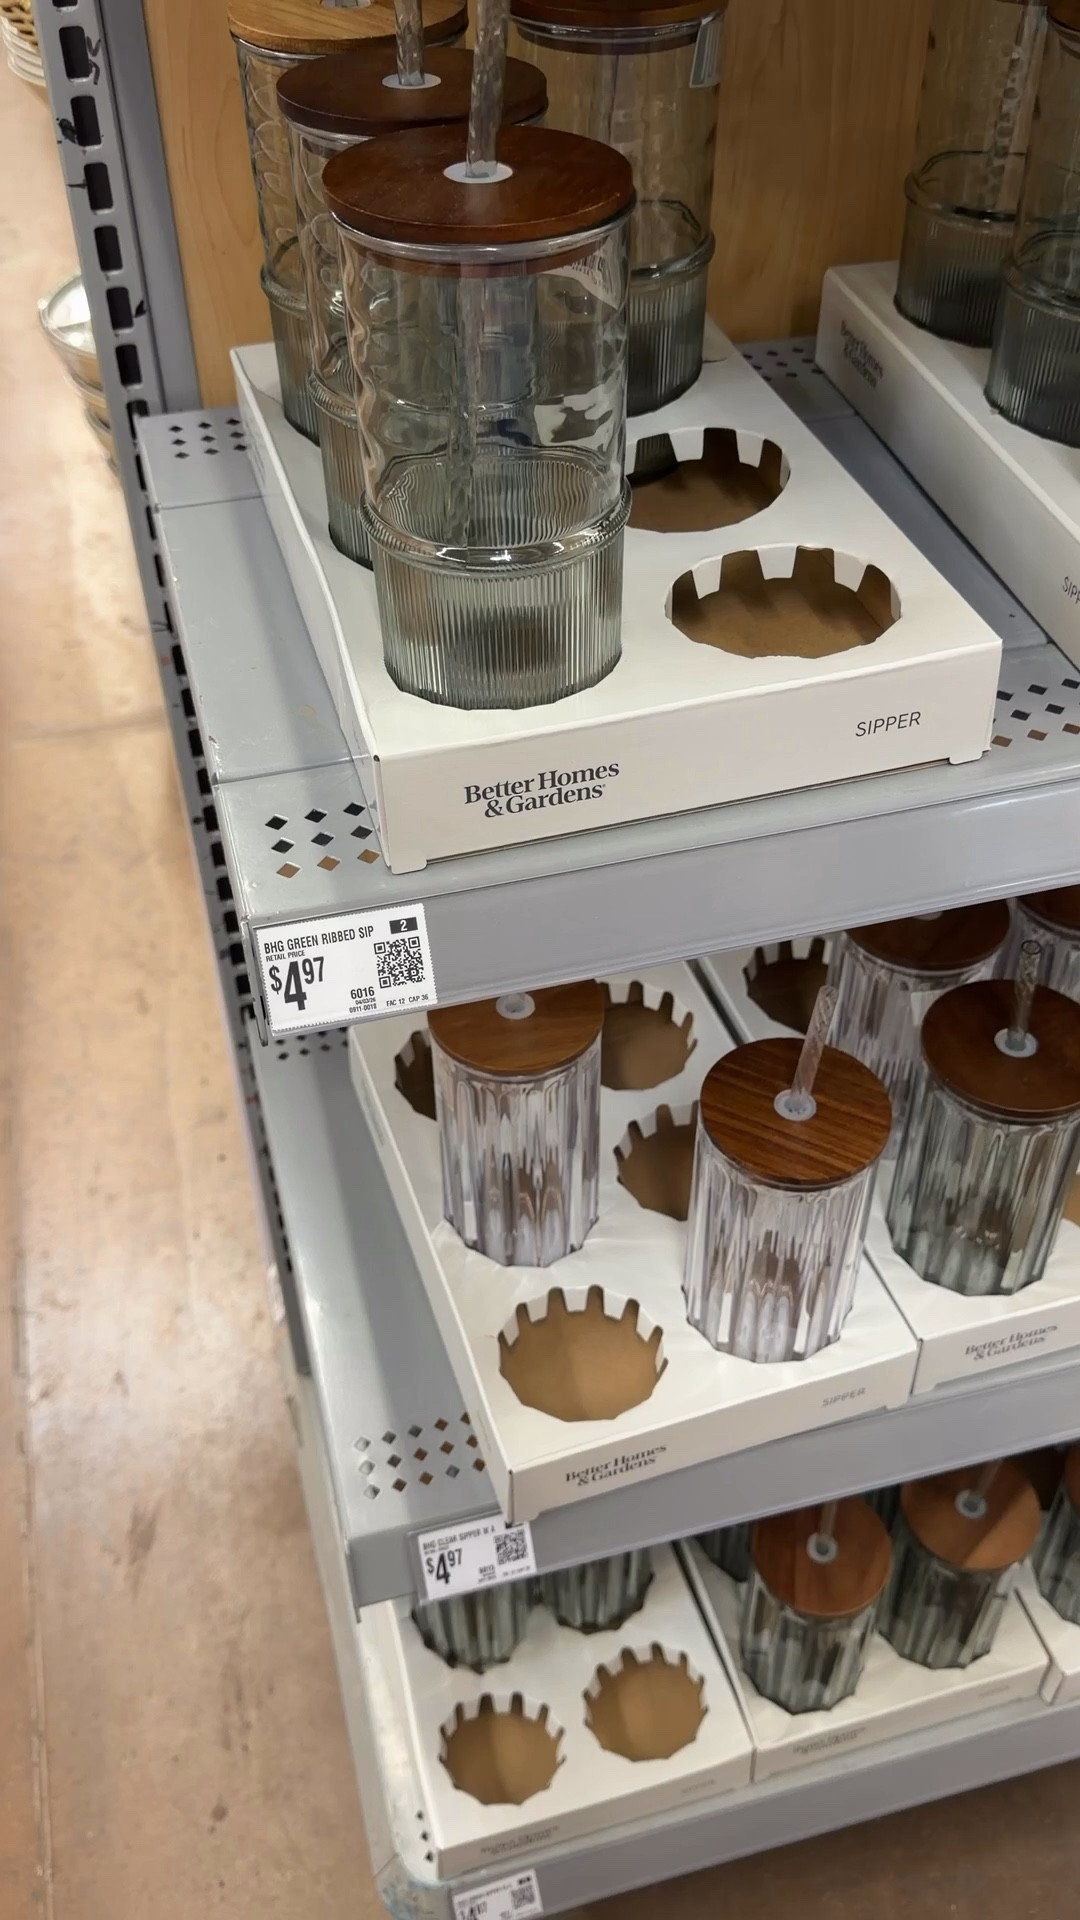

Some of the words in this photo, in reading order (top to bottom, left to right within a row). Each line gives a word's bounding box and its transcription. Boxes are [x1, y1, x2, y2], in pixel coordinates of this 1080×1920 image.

[855, 711, 921, 737] SIPPER
[464, 778, 535, 805] Better
[537, 763, 620, 791] Homes
[484, 799, 504, 818] &
[505, 784, 603, 814] Gardens
[400, 919, 408, 932] 2
[264, 940, 285, 954] BHG
[287, 935, 319, 951] GREEN
[321, 928, 356, 945] RIBBED
[358, 925, 374, 939] SIP
[265, 953, 287, 962] RETAIL
[287, 950, 306, 959] PRICE
[350, 986, 375, 1000] 6016
[386, 999, 397, 1007] FAC
[408, 995, 421, 1003] CAP
